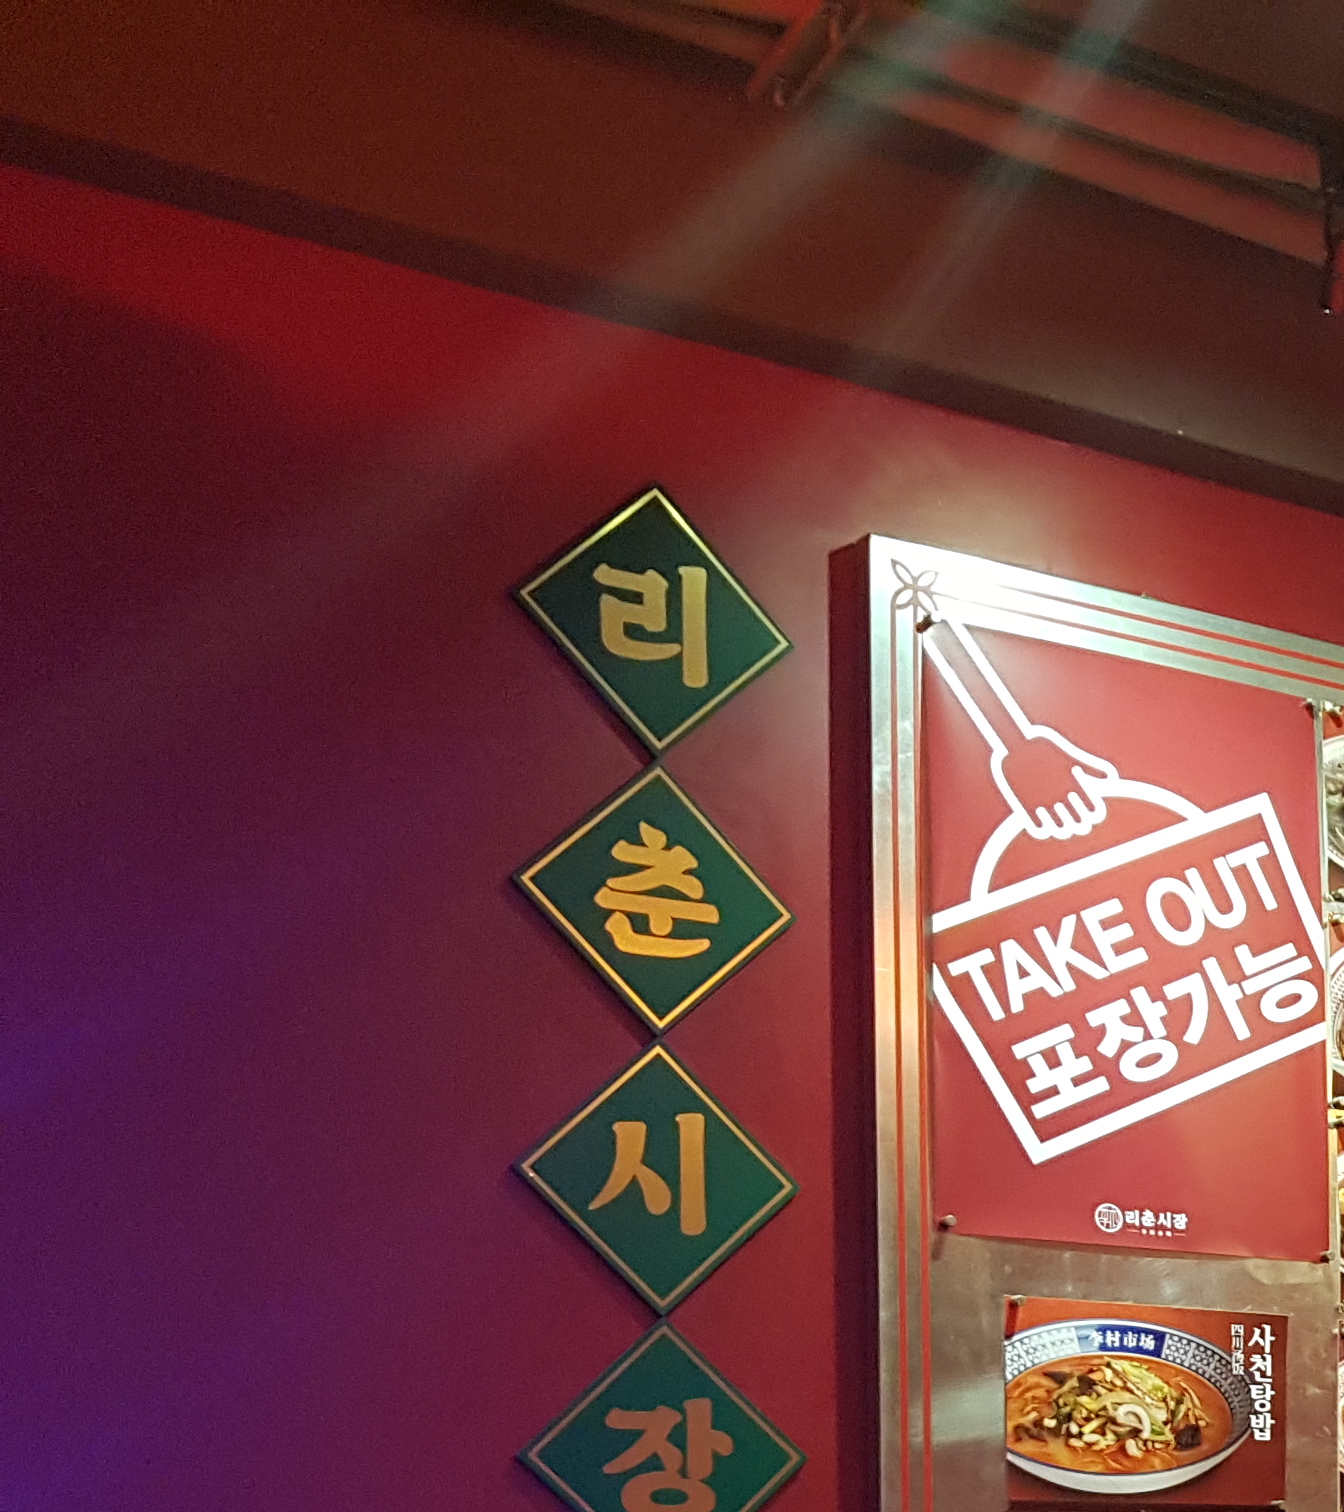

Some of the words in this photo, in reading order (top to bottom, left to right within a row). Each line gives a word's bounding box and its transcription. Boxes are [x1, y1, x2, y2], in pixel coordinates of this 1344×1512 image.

[948, 898, 1149, 1023] TAKE
[1144, 840, 1279, 948] OUT
[1011, 939, 1322, 1121] 포장가능
[1124, 1208, 1188, 1230] 리춘시장
[1248, 1323, 1276, 1441] 사천탕밥
